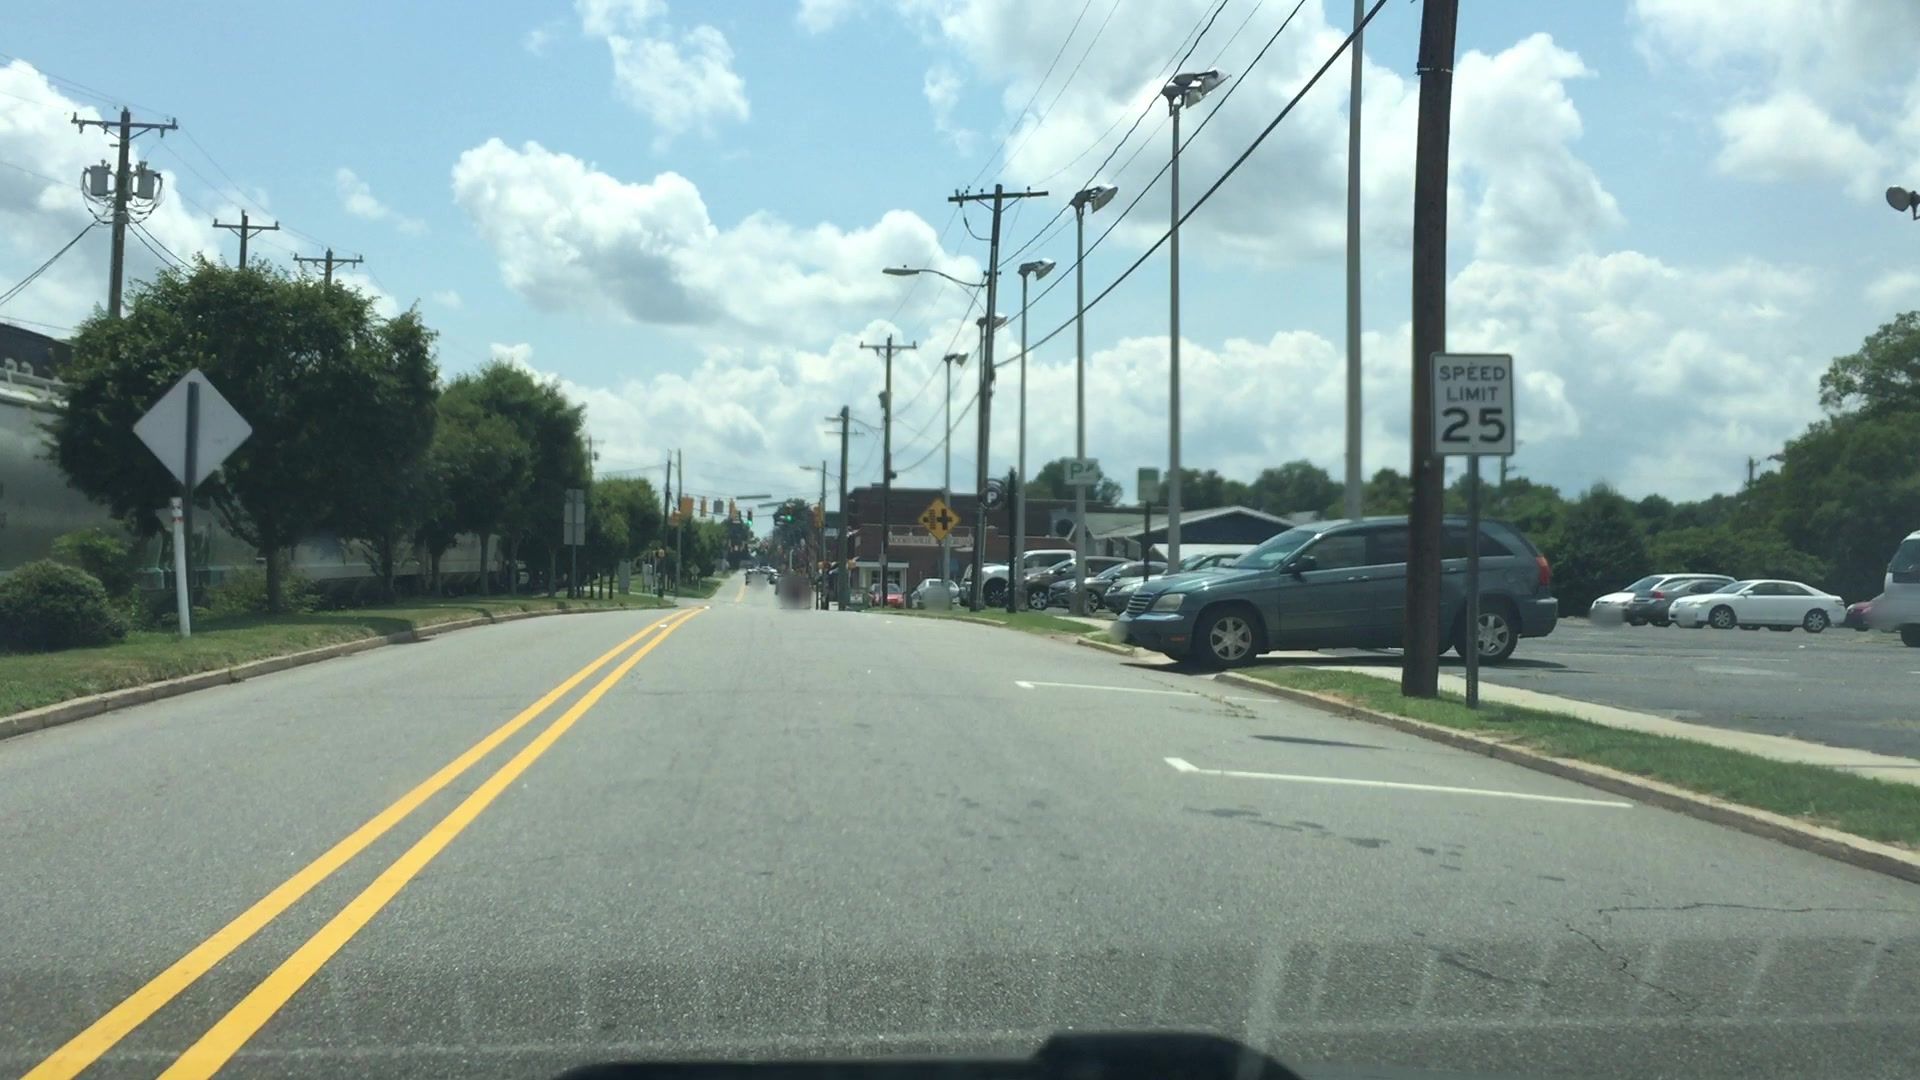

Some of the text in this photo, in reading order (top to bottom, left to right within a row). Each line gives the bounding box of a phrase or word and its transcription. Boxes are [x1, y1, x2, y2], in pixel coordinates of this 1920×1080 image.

[1439, 365, 1506, 381] SPEED
[1446, 386, 1498, 402] LIMIT
[1441, 406, 1506, 443] 25
